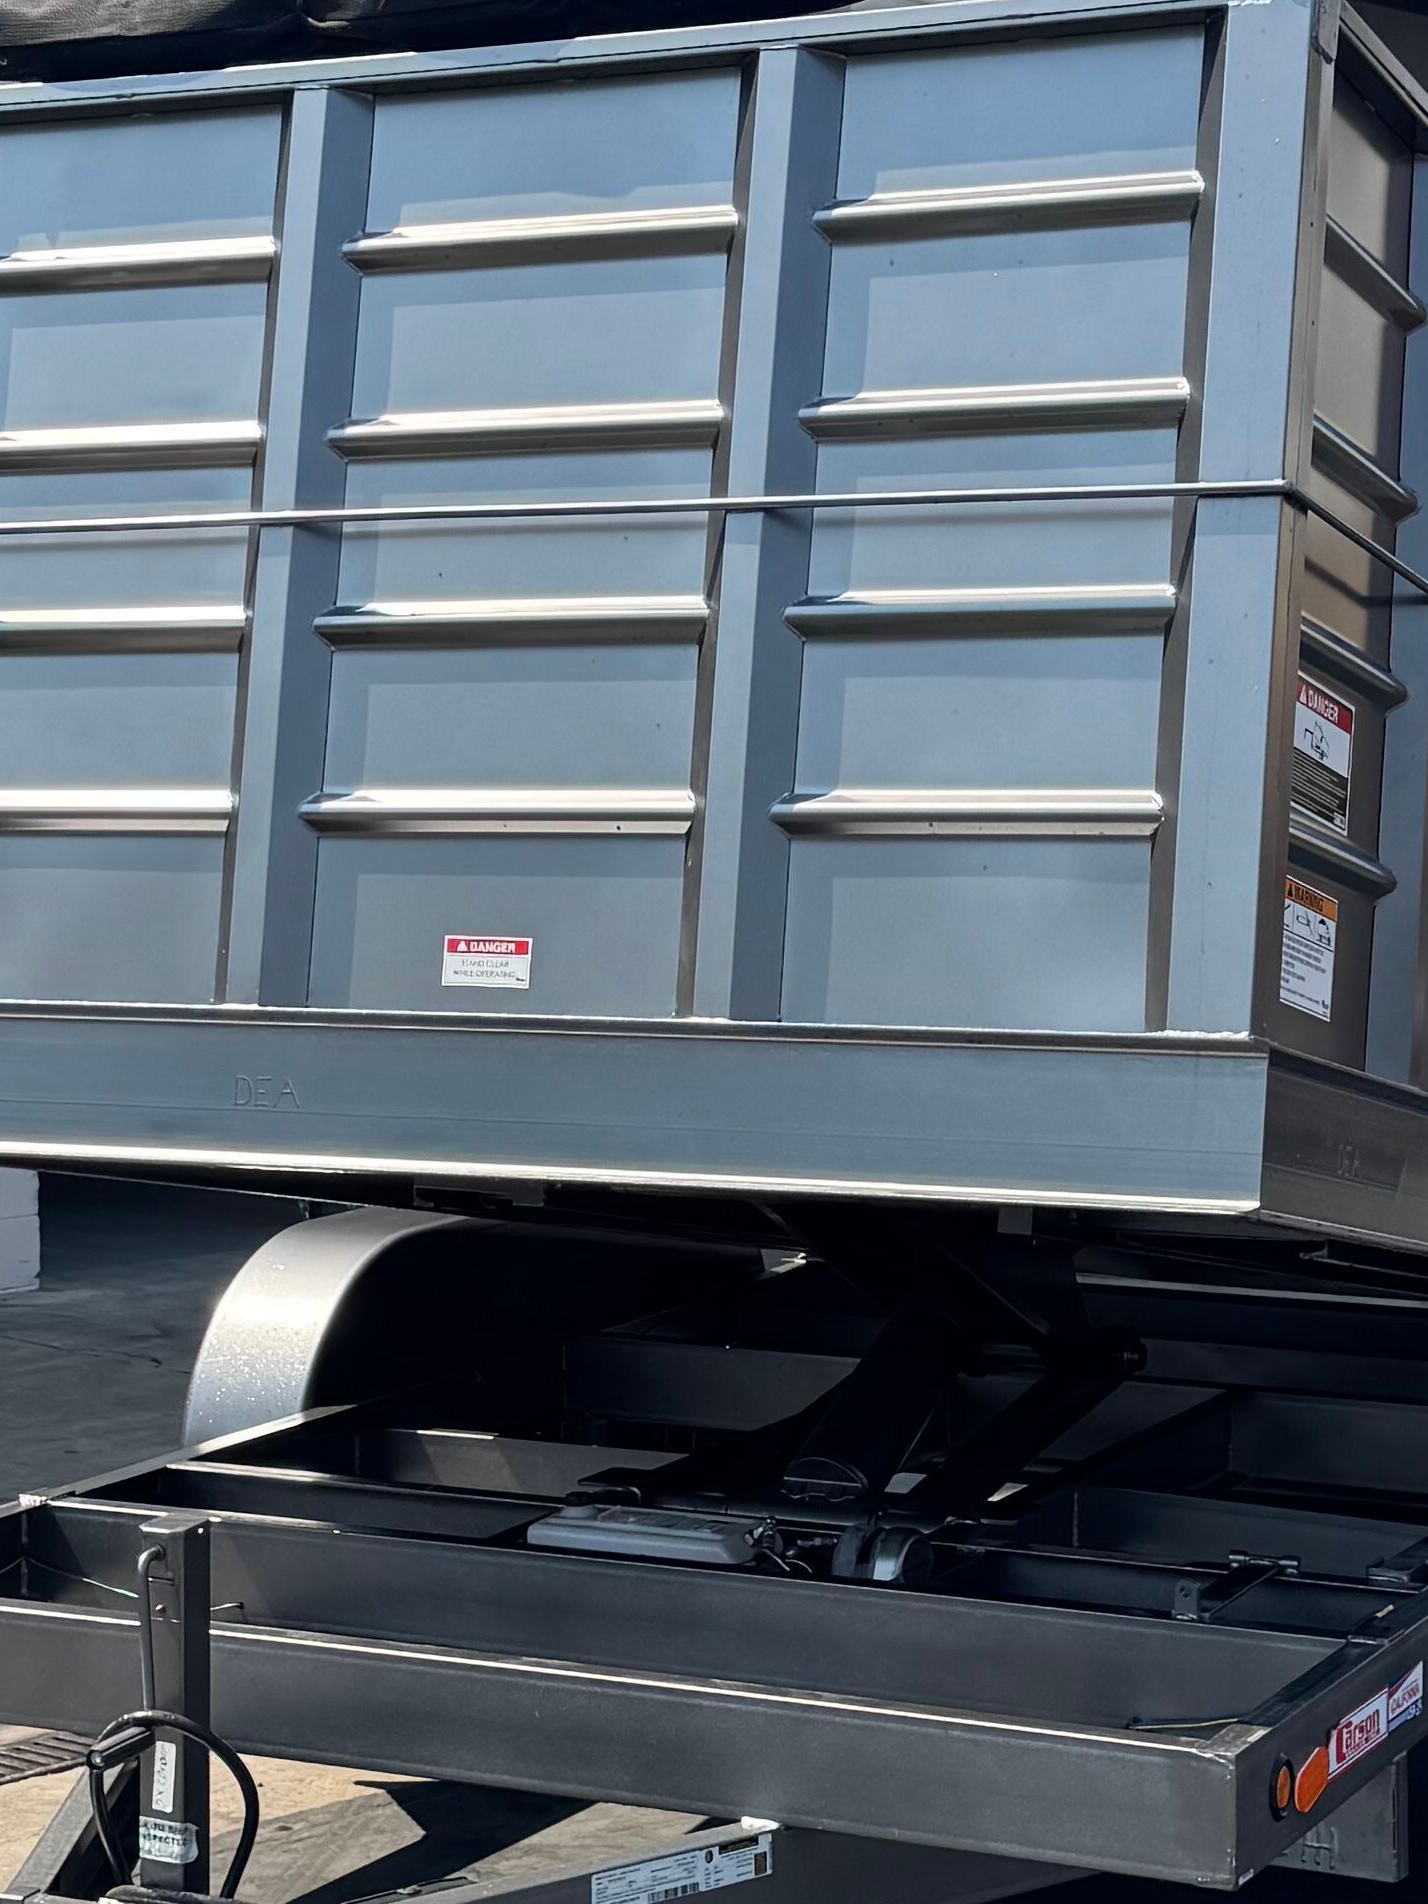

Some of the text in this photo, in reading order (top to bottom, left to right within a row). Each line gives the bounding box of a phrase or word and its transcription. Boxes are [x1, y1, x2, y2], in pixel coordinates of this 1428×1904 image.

[1308, 689, 1339, 724] DANGER
[469, 940, 516, 954] DANGER
[1335, 1708, 1381, 1765] Carson
